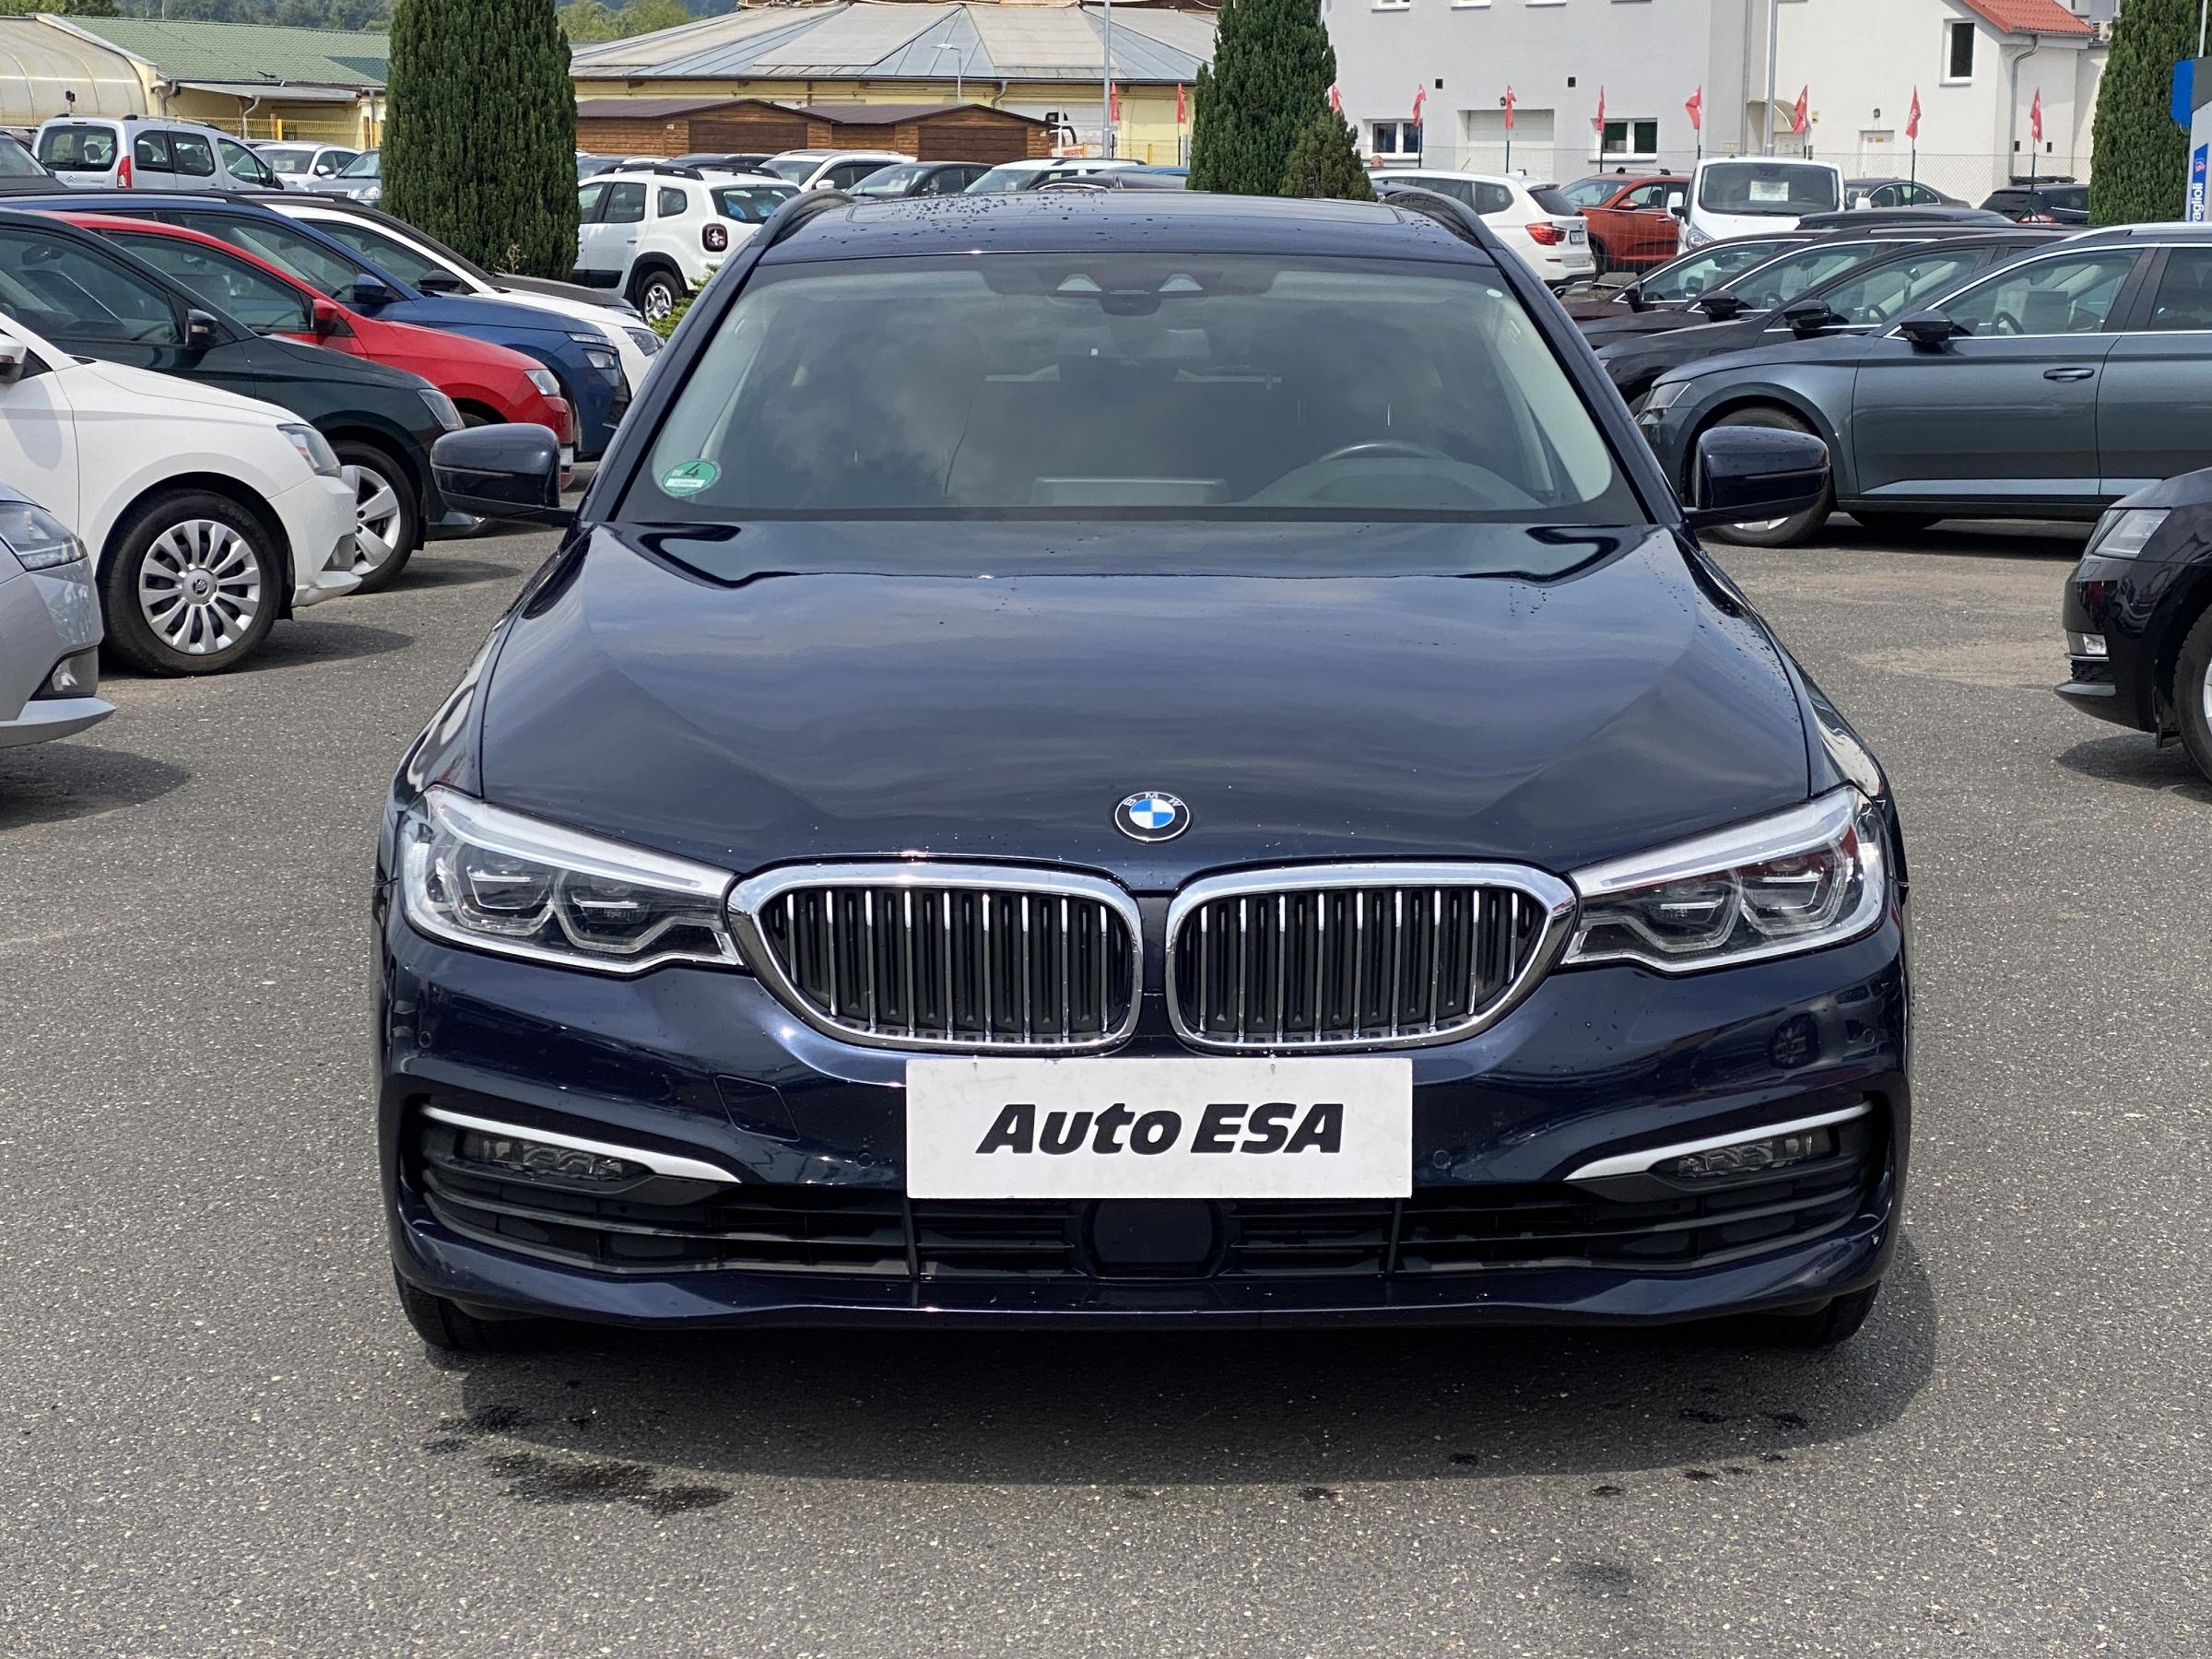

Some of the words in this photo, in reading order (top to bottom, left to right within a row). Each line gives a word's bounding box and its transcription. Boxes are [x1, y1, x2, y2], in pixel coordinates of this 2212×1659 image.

[683, 463, 701, 477] 4
[976, 1102, 1182, 1155] Auto
[1190, 1102, 1345, 1154] ESA
